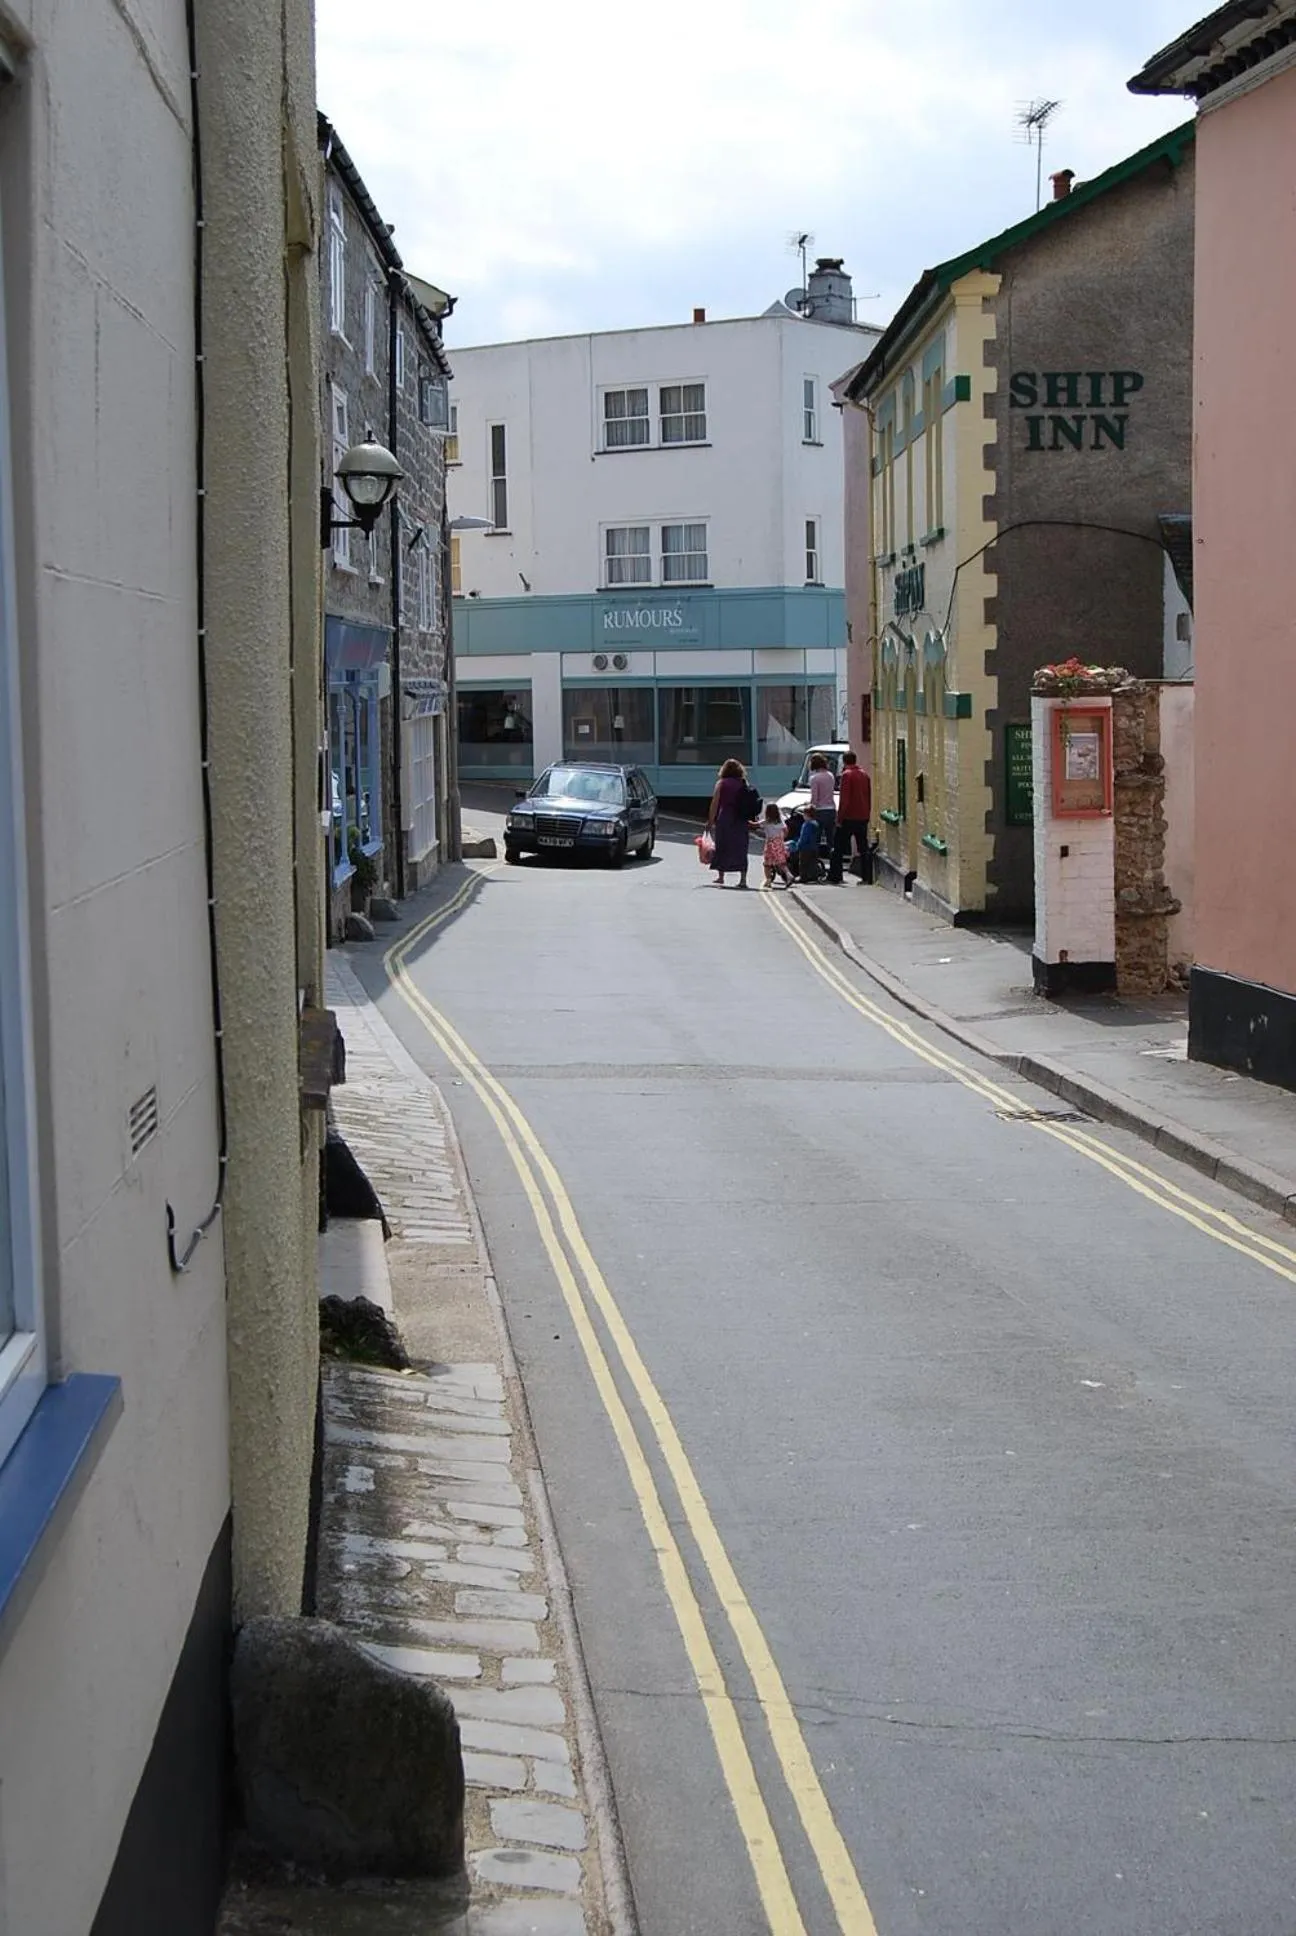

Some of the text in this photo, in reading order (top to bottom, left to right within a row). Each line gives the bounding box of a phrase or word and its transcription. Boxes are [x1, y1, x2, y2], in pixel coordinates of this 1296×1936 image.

[1009, 371, 1144, 408] SHIP
[1024, 414, 1129, 451] INN
[604, 609, 683, 629] RUMOURS
